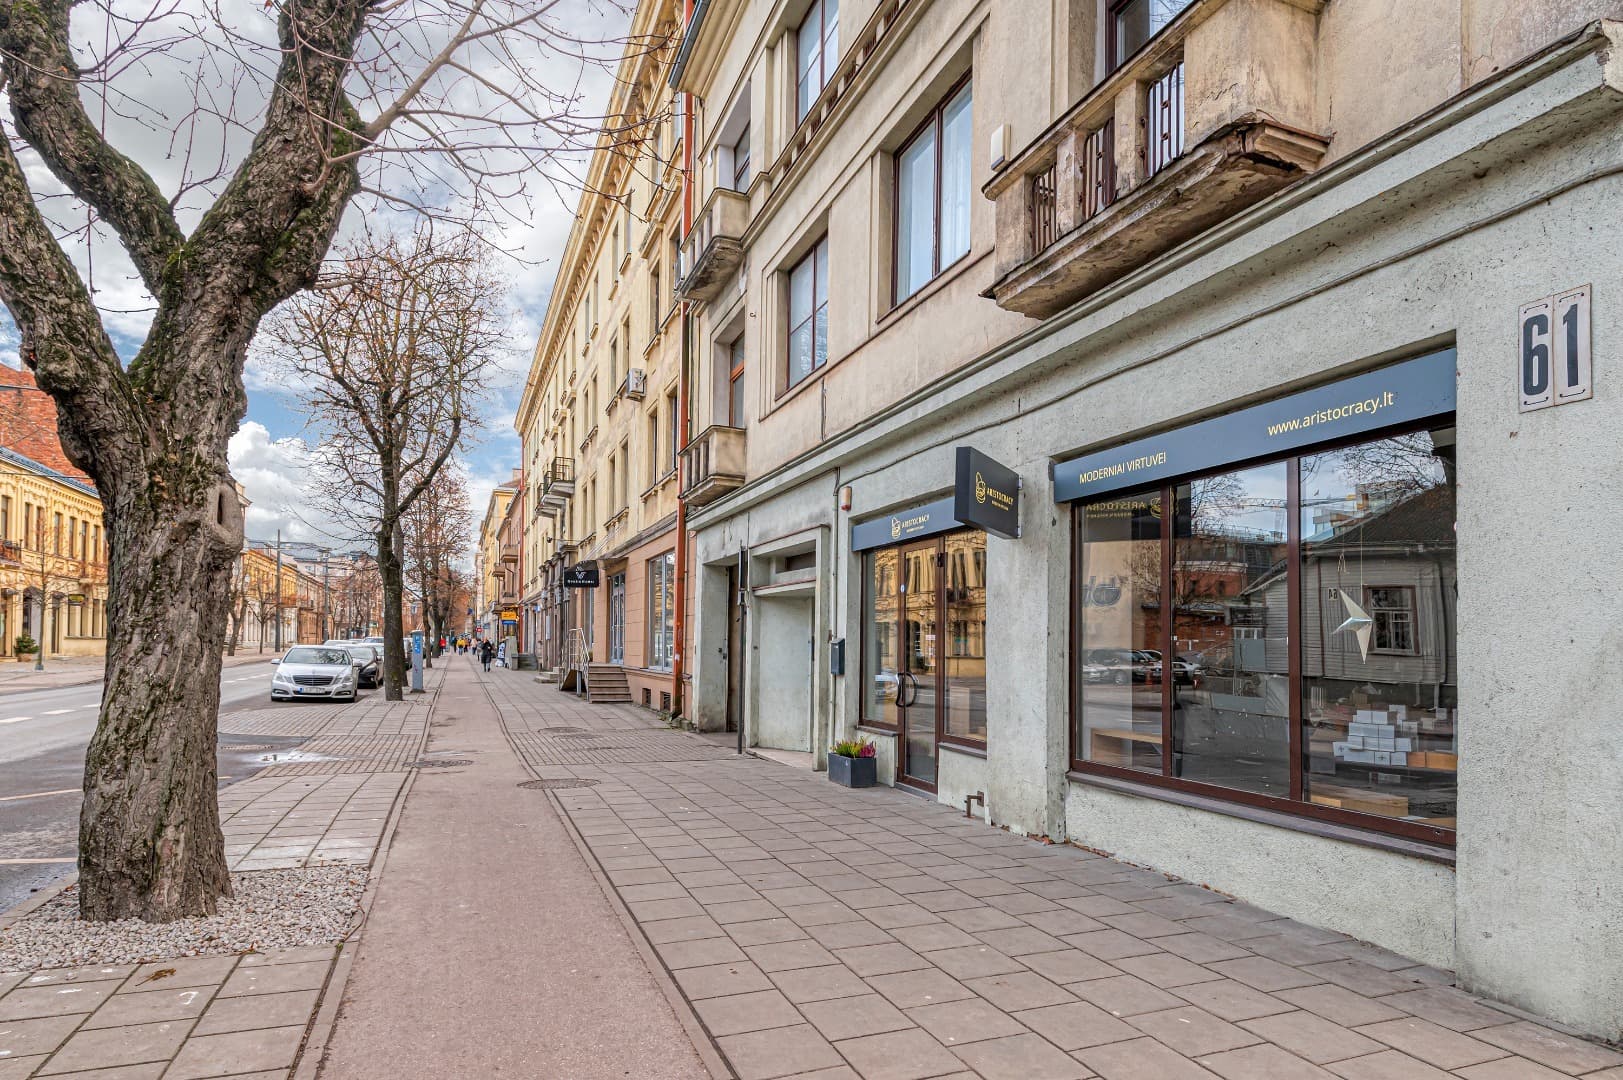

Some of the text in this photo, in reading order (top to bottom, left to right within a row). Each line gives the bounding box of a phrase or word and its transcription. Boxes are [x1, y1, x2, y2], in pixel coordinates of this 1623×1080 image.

[1523, 304, 1579, 396] 61
[1268, 391, 1394, 436] www.aristocracy.lt
[1079, 451, 1166, 484] MODERNIAI VIRTUVEI
[987, 487, 1014, 505] ARISTOCRACY
[902, 514, 930, 528] ARISTOCRACY
